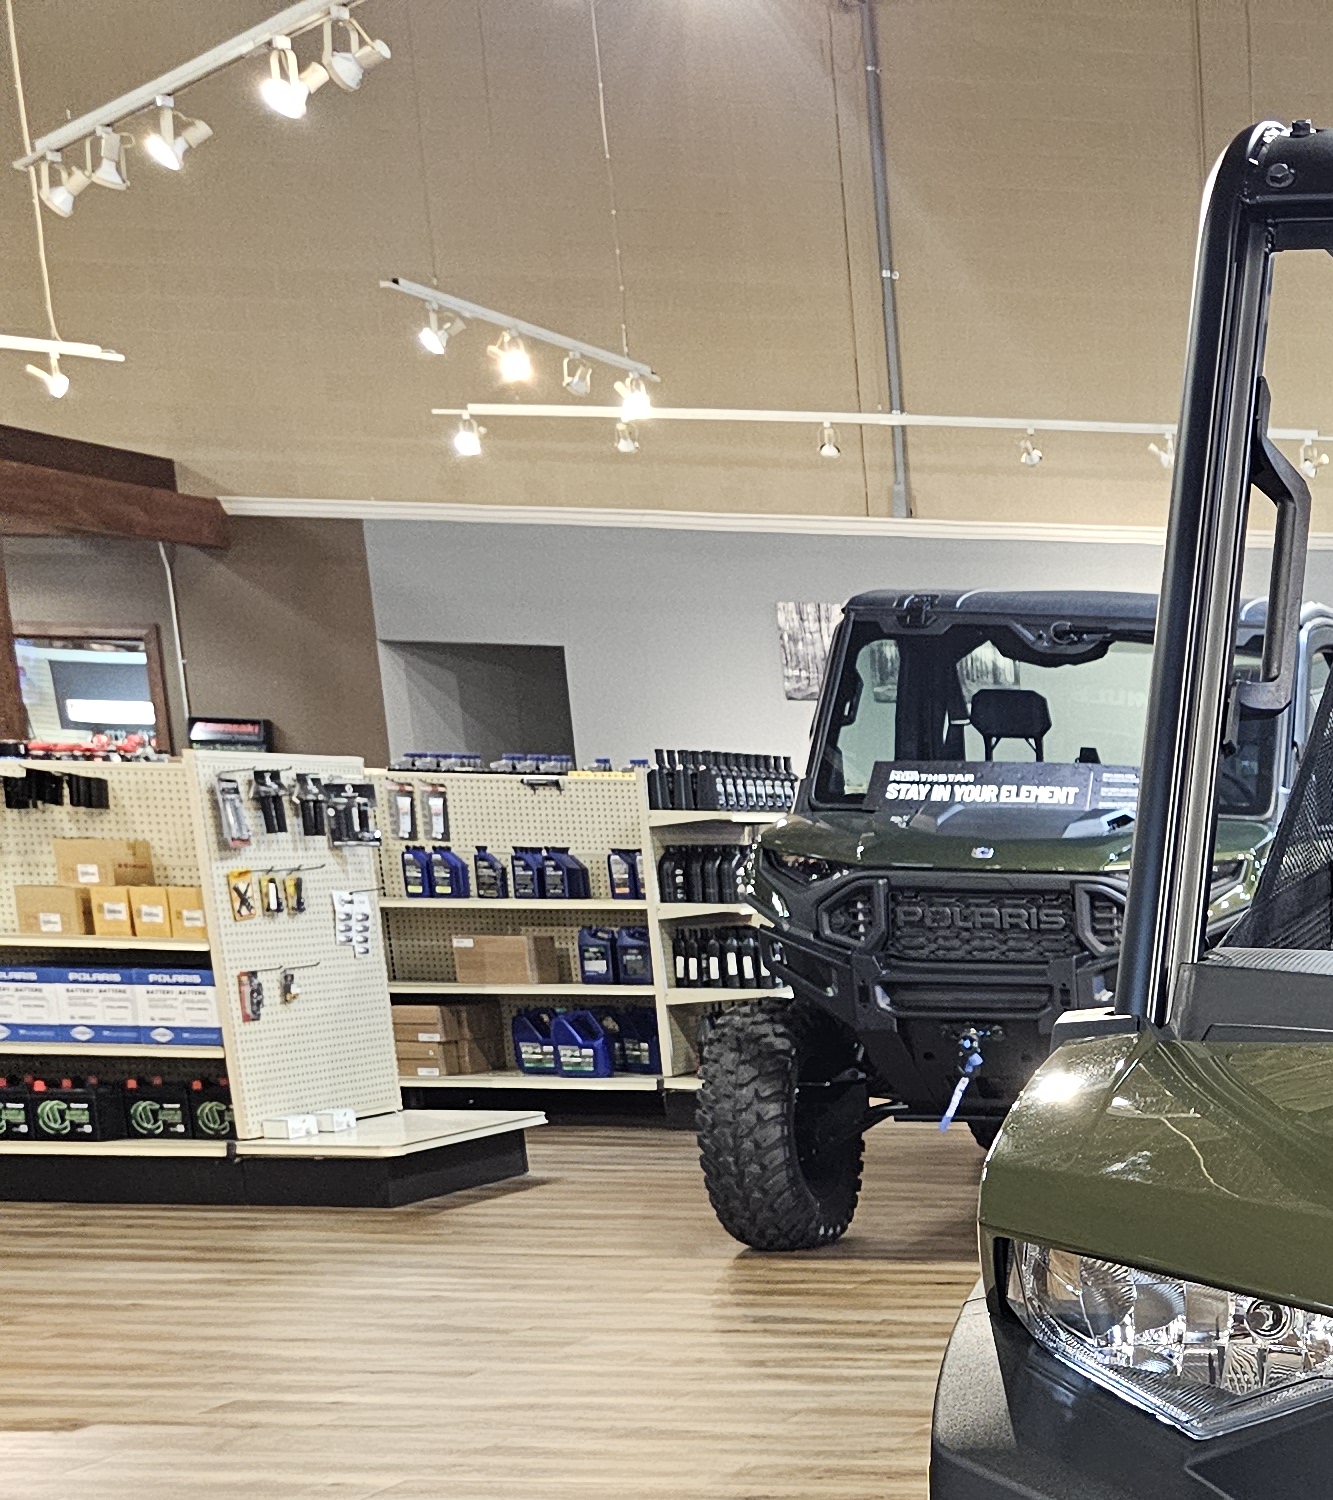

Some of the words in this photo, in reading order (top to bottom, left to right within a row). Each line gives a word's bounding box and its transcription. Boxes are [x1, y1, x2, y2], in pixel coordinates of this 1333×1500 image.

[885, 783, 931, 800] STAY
[931, 785, 951, 802] IN
[954, 785, 998, 803] YOUR
[999, 785, 1079, 804] ELEMENT
[896, 907, 1066, 930] POLARIS
